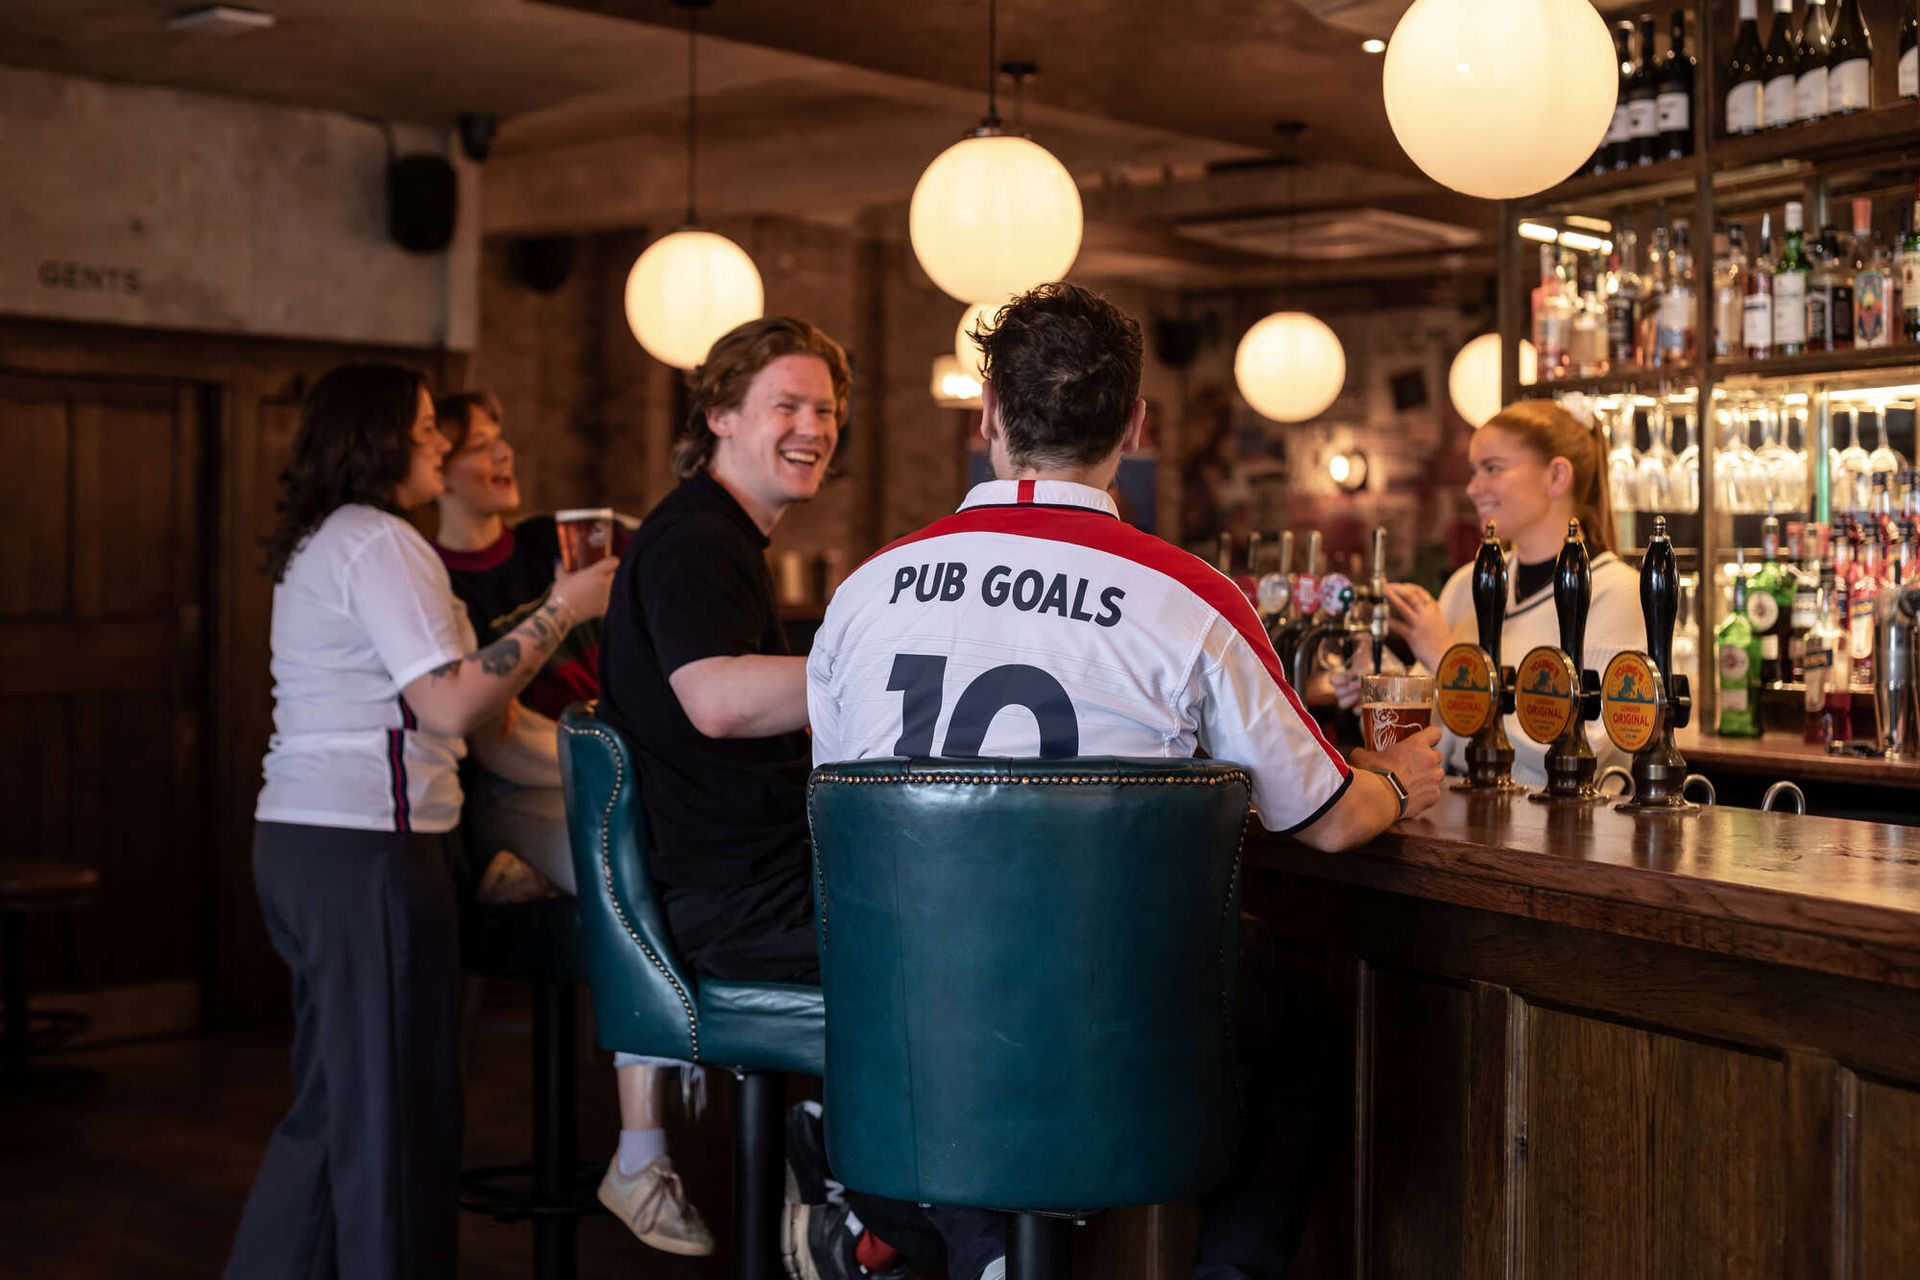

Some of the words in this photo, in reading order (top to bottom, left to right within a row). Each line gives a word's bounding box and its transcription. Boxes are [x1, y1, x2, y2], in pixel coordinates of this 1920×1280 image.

[38, 259, 141, 296] GENTS
[888, 562, 968, 604] PUB
[981, 565, 1126, 627] GOALS
[886, 653, 1079, 757] 10
[1527, 704, 1562, 720] ORIGINAL
[1612, 712, 1649, 726] ORIGINAL
